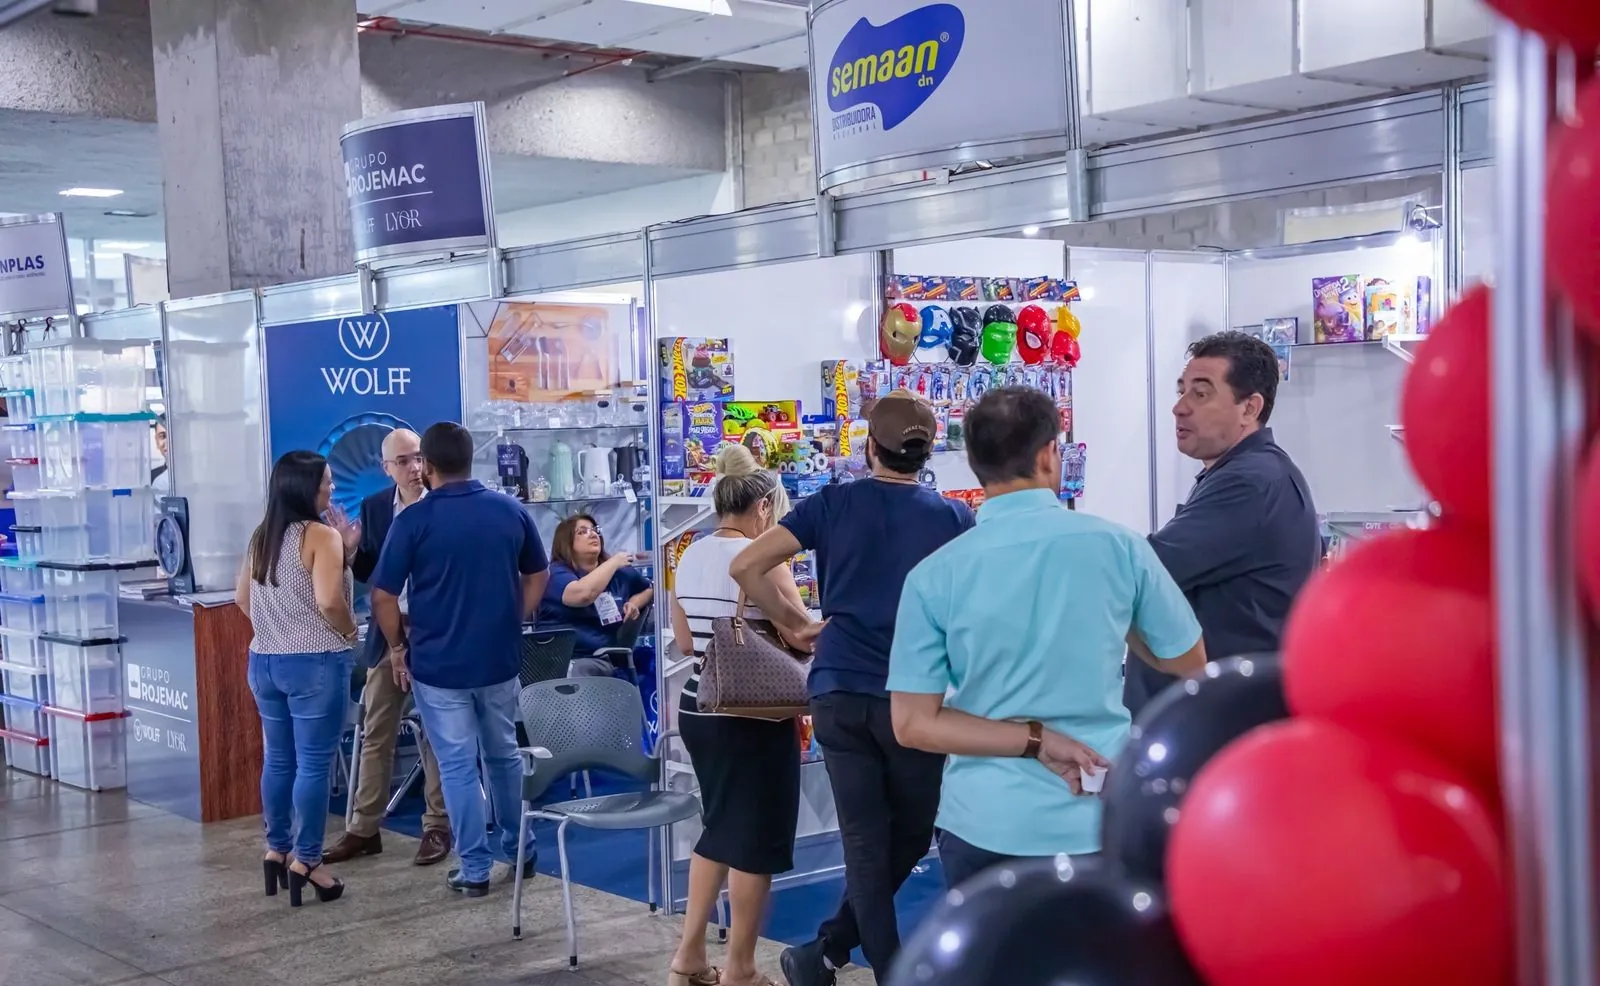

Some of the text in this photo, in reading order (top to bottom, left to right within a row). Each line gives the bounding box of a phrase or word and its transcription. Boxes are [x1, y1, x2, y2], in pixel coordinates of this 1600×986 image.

[831, 40, 939, 97] semaan
[917, 75, 934, 87] dn
[349, 151, 387, 173] GRUPO
[351, 163, 426, 196] ROJEMAC
[385, 209, 423, 232] LYOR
[346, 321, 381, 349] W
[320, 367, 411, 395] WOLFF
[140, 665, 170, 684] GRUPO
[141, 682, 189, 711] ROJEMAC
[166, 729, 187, 752] LYOR
